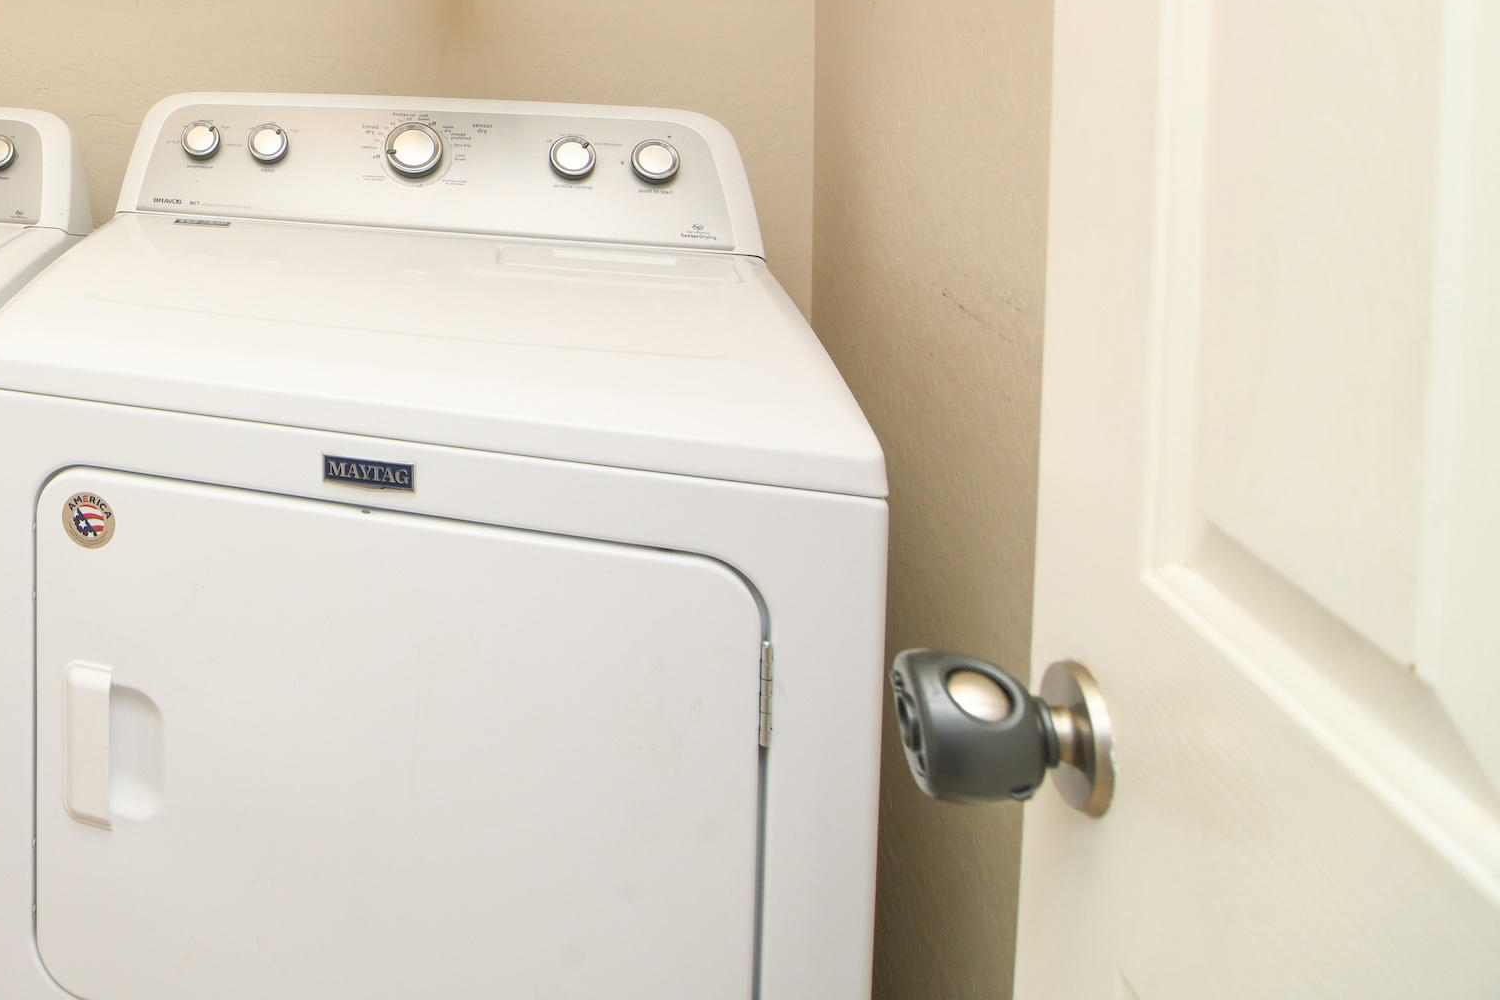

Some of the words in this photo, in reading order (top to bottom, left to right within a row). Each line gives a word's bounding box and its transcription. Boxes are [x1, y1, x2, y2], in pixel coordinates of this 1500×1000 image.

[153, 197, 182, 205] BRAVOS
[328, 460, 410, 485] MAYTAG
[68, 495, 112, 520] AMERICA
